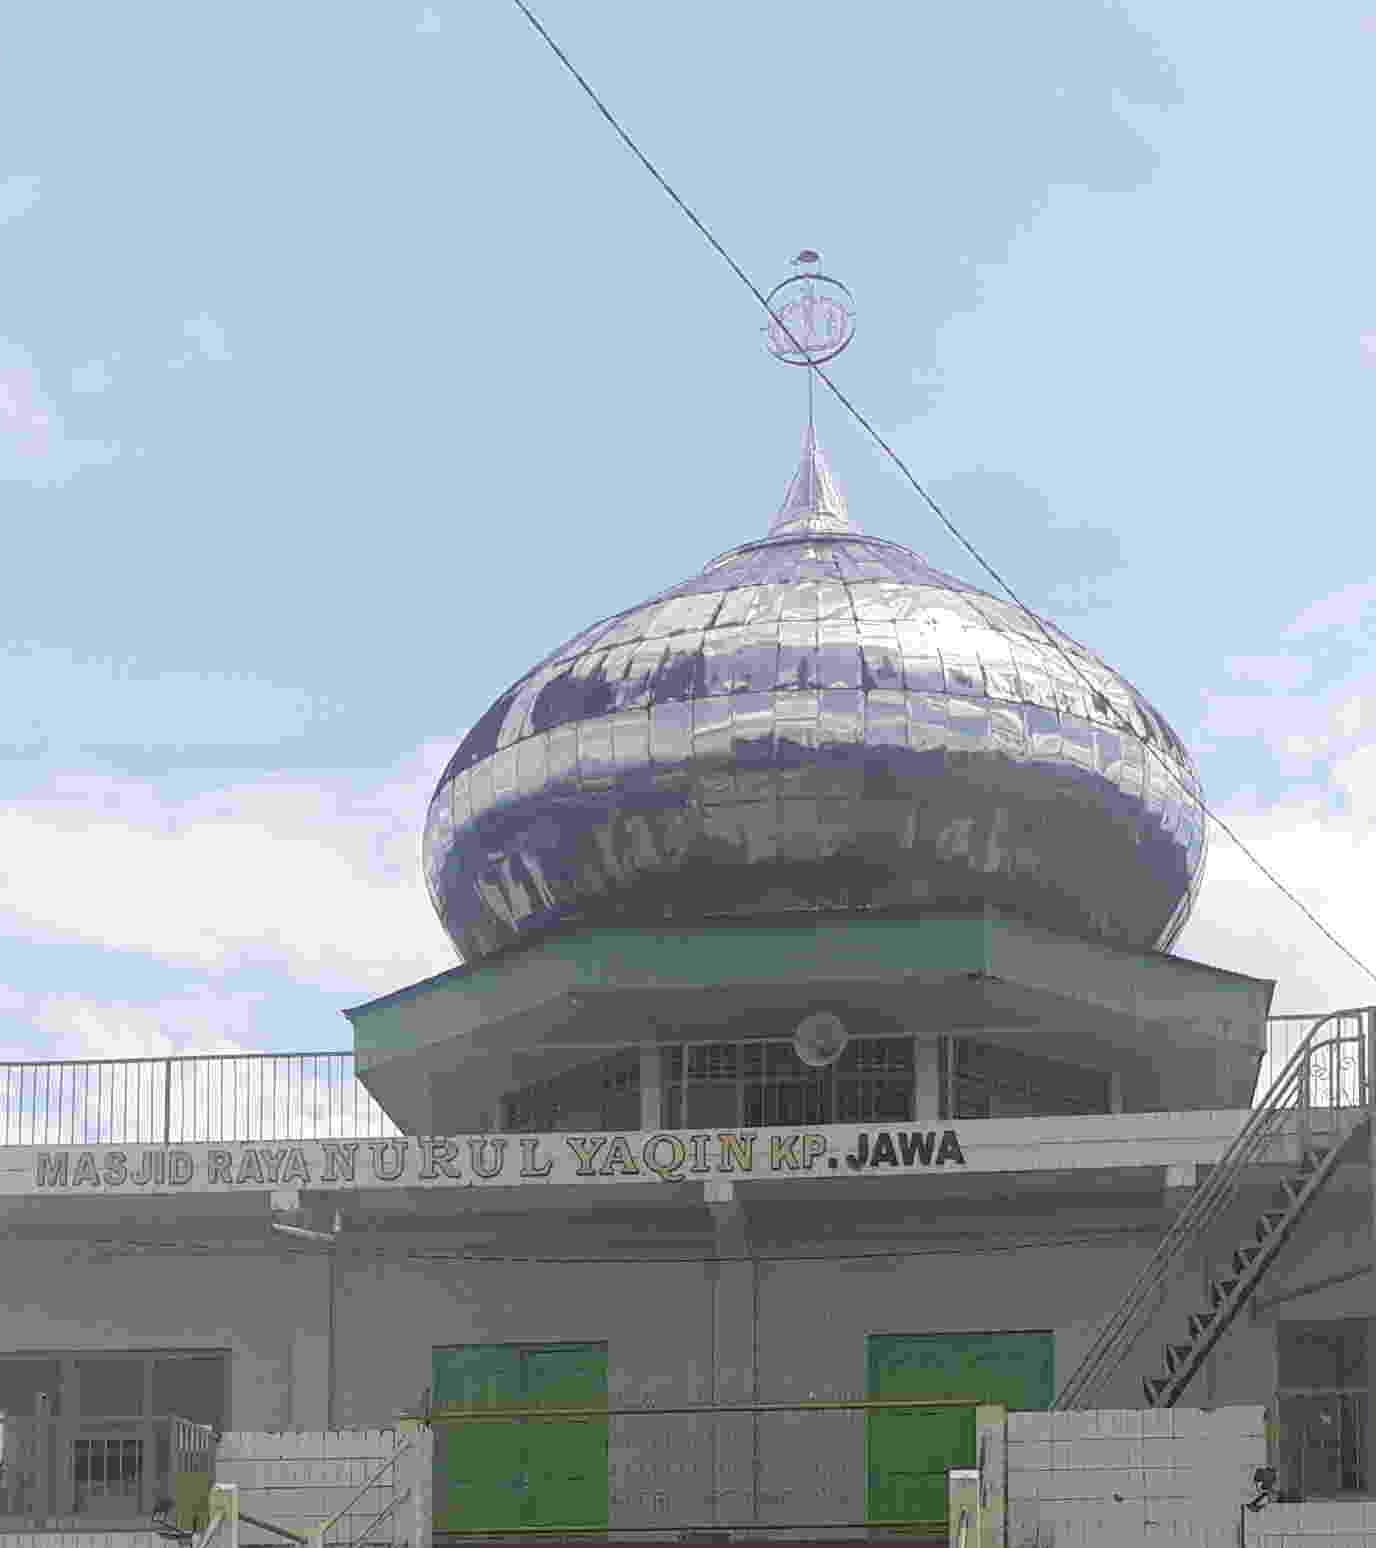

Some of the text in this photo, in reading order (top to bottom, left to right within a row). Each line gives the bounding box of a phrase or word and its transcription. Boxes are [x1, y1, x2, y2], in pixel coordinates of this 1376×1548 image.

[35, 1151, 195, 1187] MASJID
[207, 1144, 312, 1184] RAYA
[320, 1135, 553, 1182] NURUL
[566, 1133, 756, 1182] YAQIN
[845, 1129, 966, 1170] JAWA
